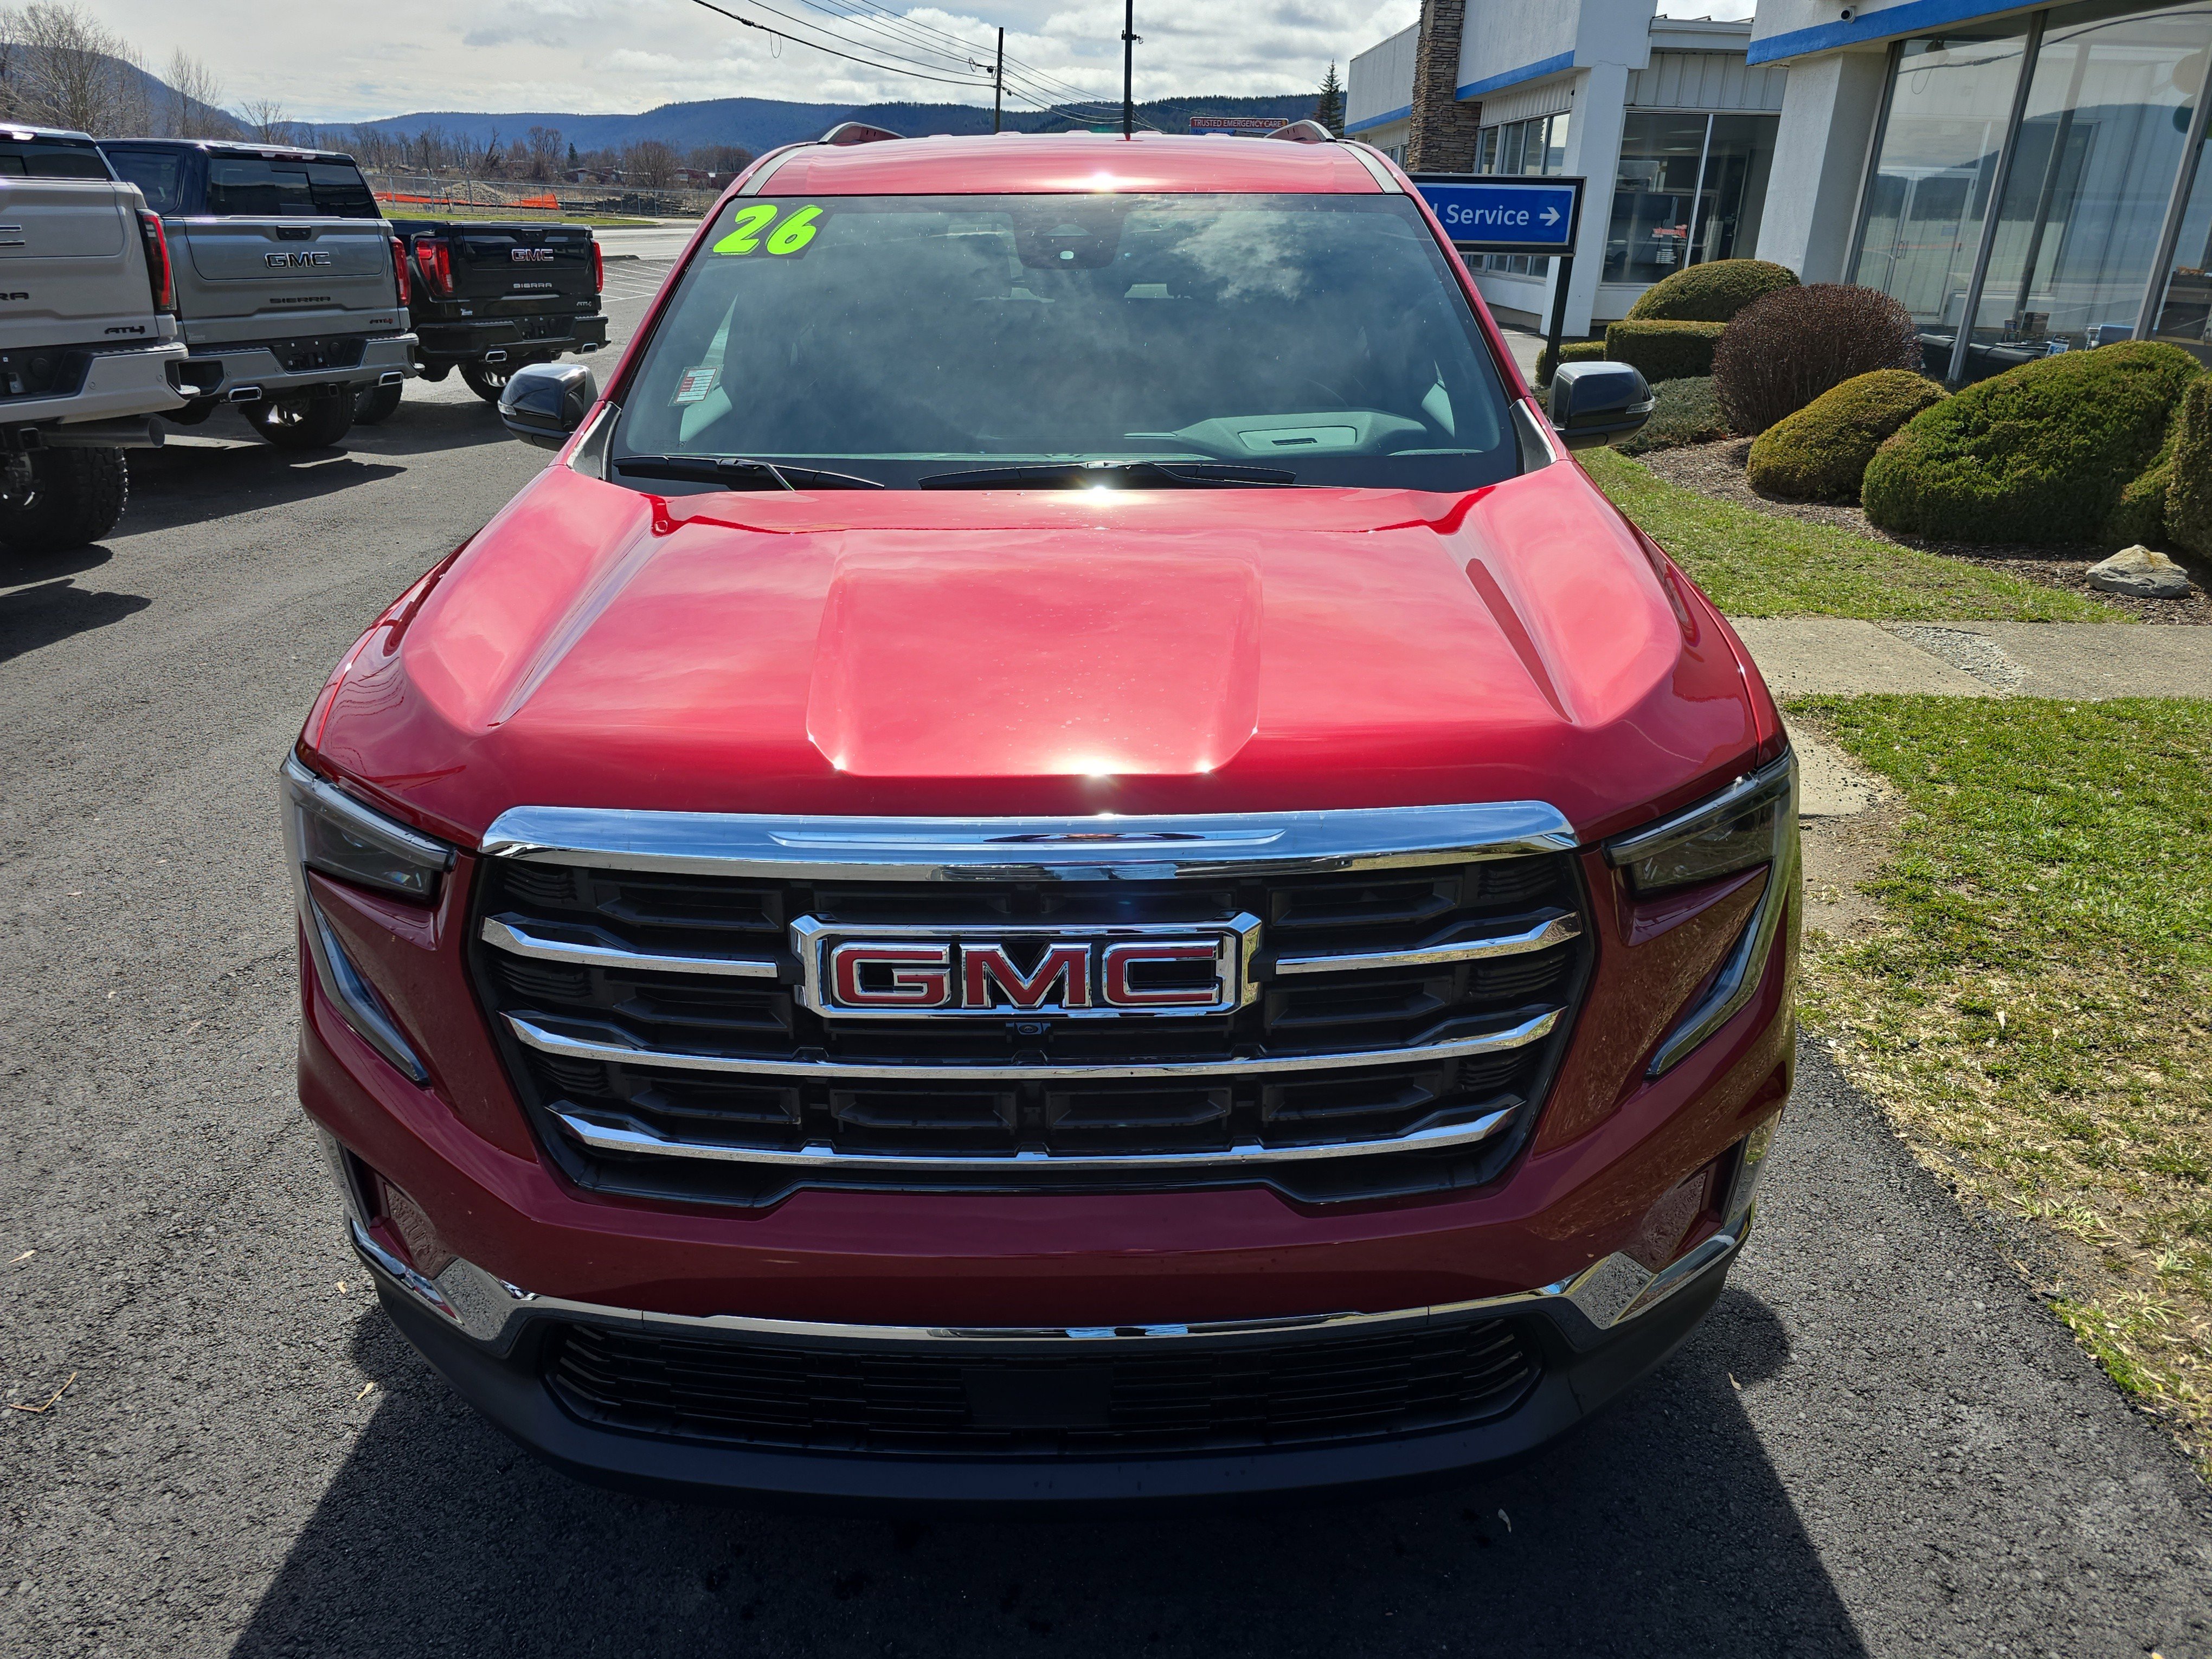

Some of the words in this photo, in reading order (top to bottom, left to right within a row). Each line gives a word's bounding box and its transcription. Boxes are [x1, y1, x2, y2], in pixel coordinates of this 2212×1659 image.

[1223, 119, 1263, 127] EMERGENCY
[1445, 204, 1529, 226] Service
[713, 204, 824, 255] 26
[265, 252, 331, 269] GMC
[511, 248, 554, 261] GMC
[104, 326, 145, 335] AT4
[830, 940, 1220, 1009] GMC
